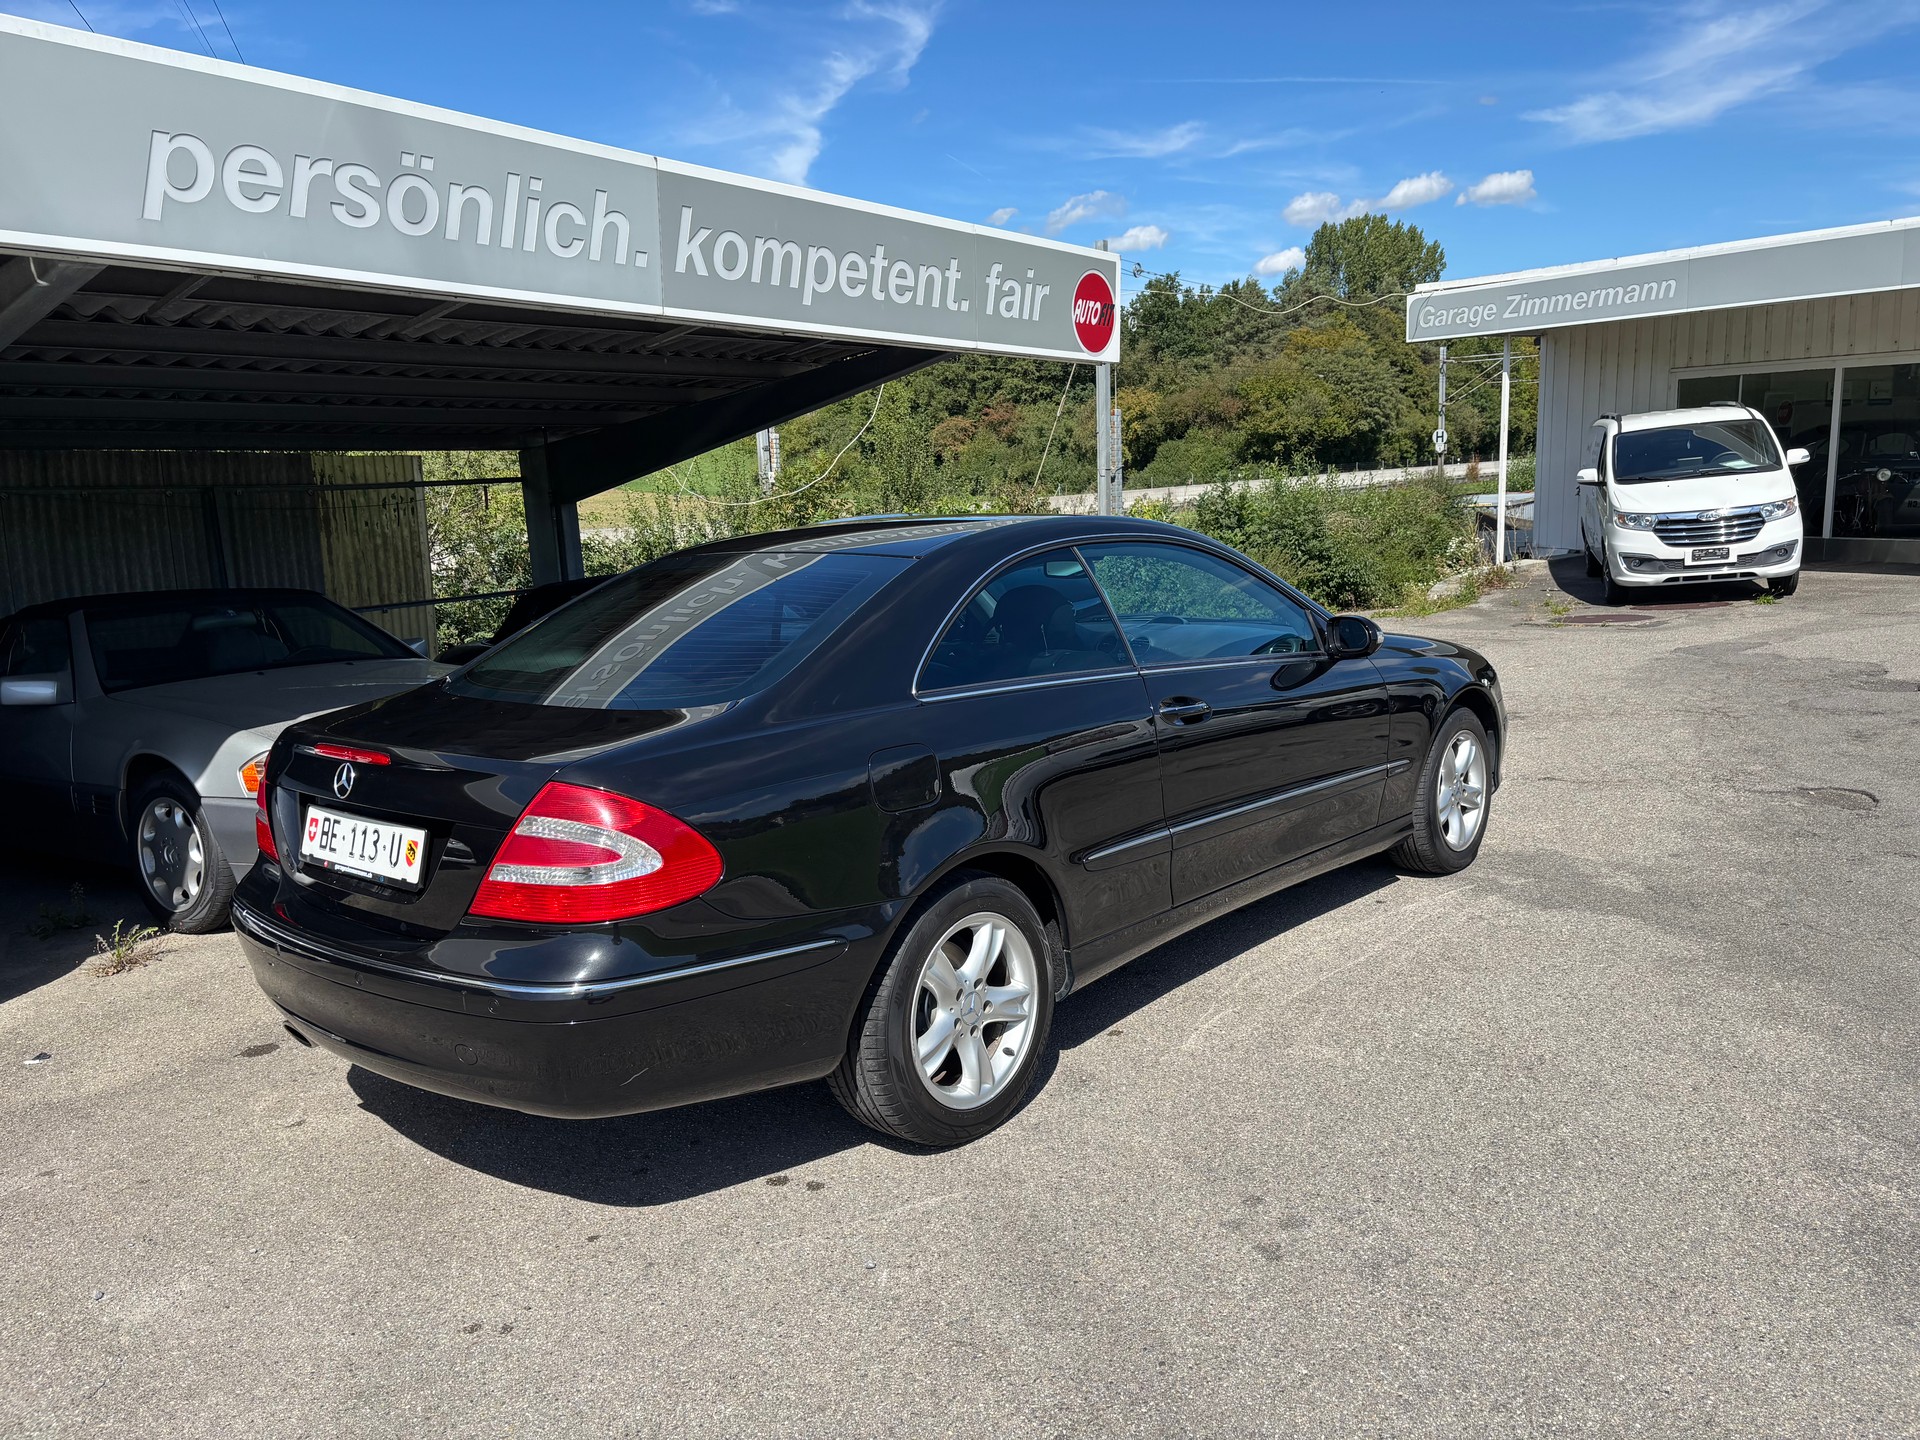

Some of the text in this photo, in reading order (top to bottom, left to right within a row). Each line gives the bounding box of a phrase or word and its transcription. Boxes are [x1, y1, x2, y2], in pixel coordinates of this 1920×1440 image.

[139, 129, 1050, 322] persönlich. kompetent. fair
[1420, 278, 1677, 328] Garage Zimmermann
[1436, 431, 1444, 442] H
